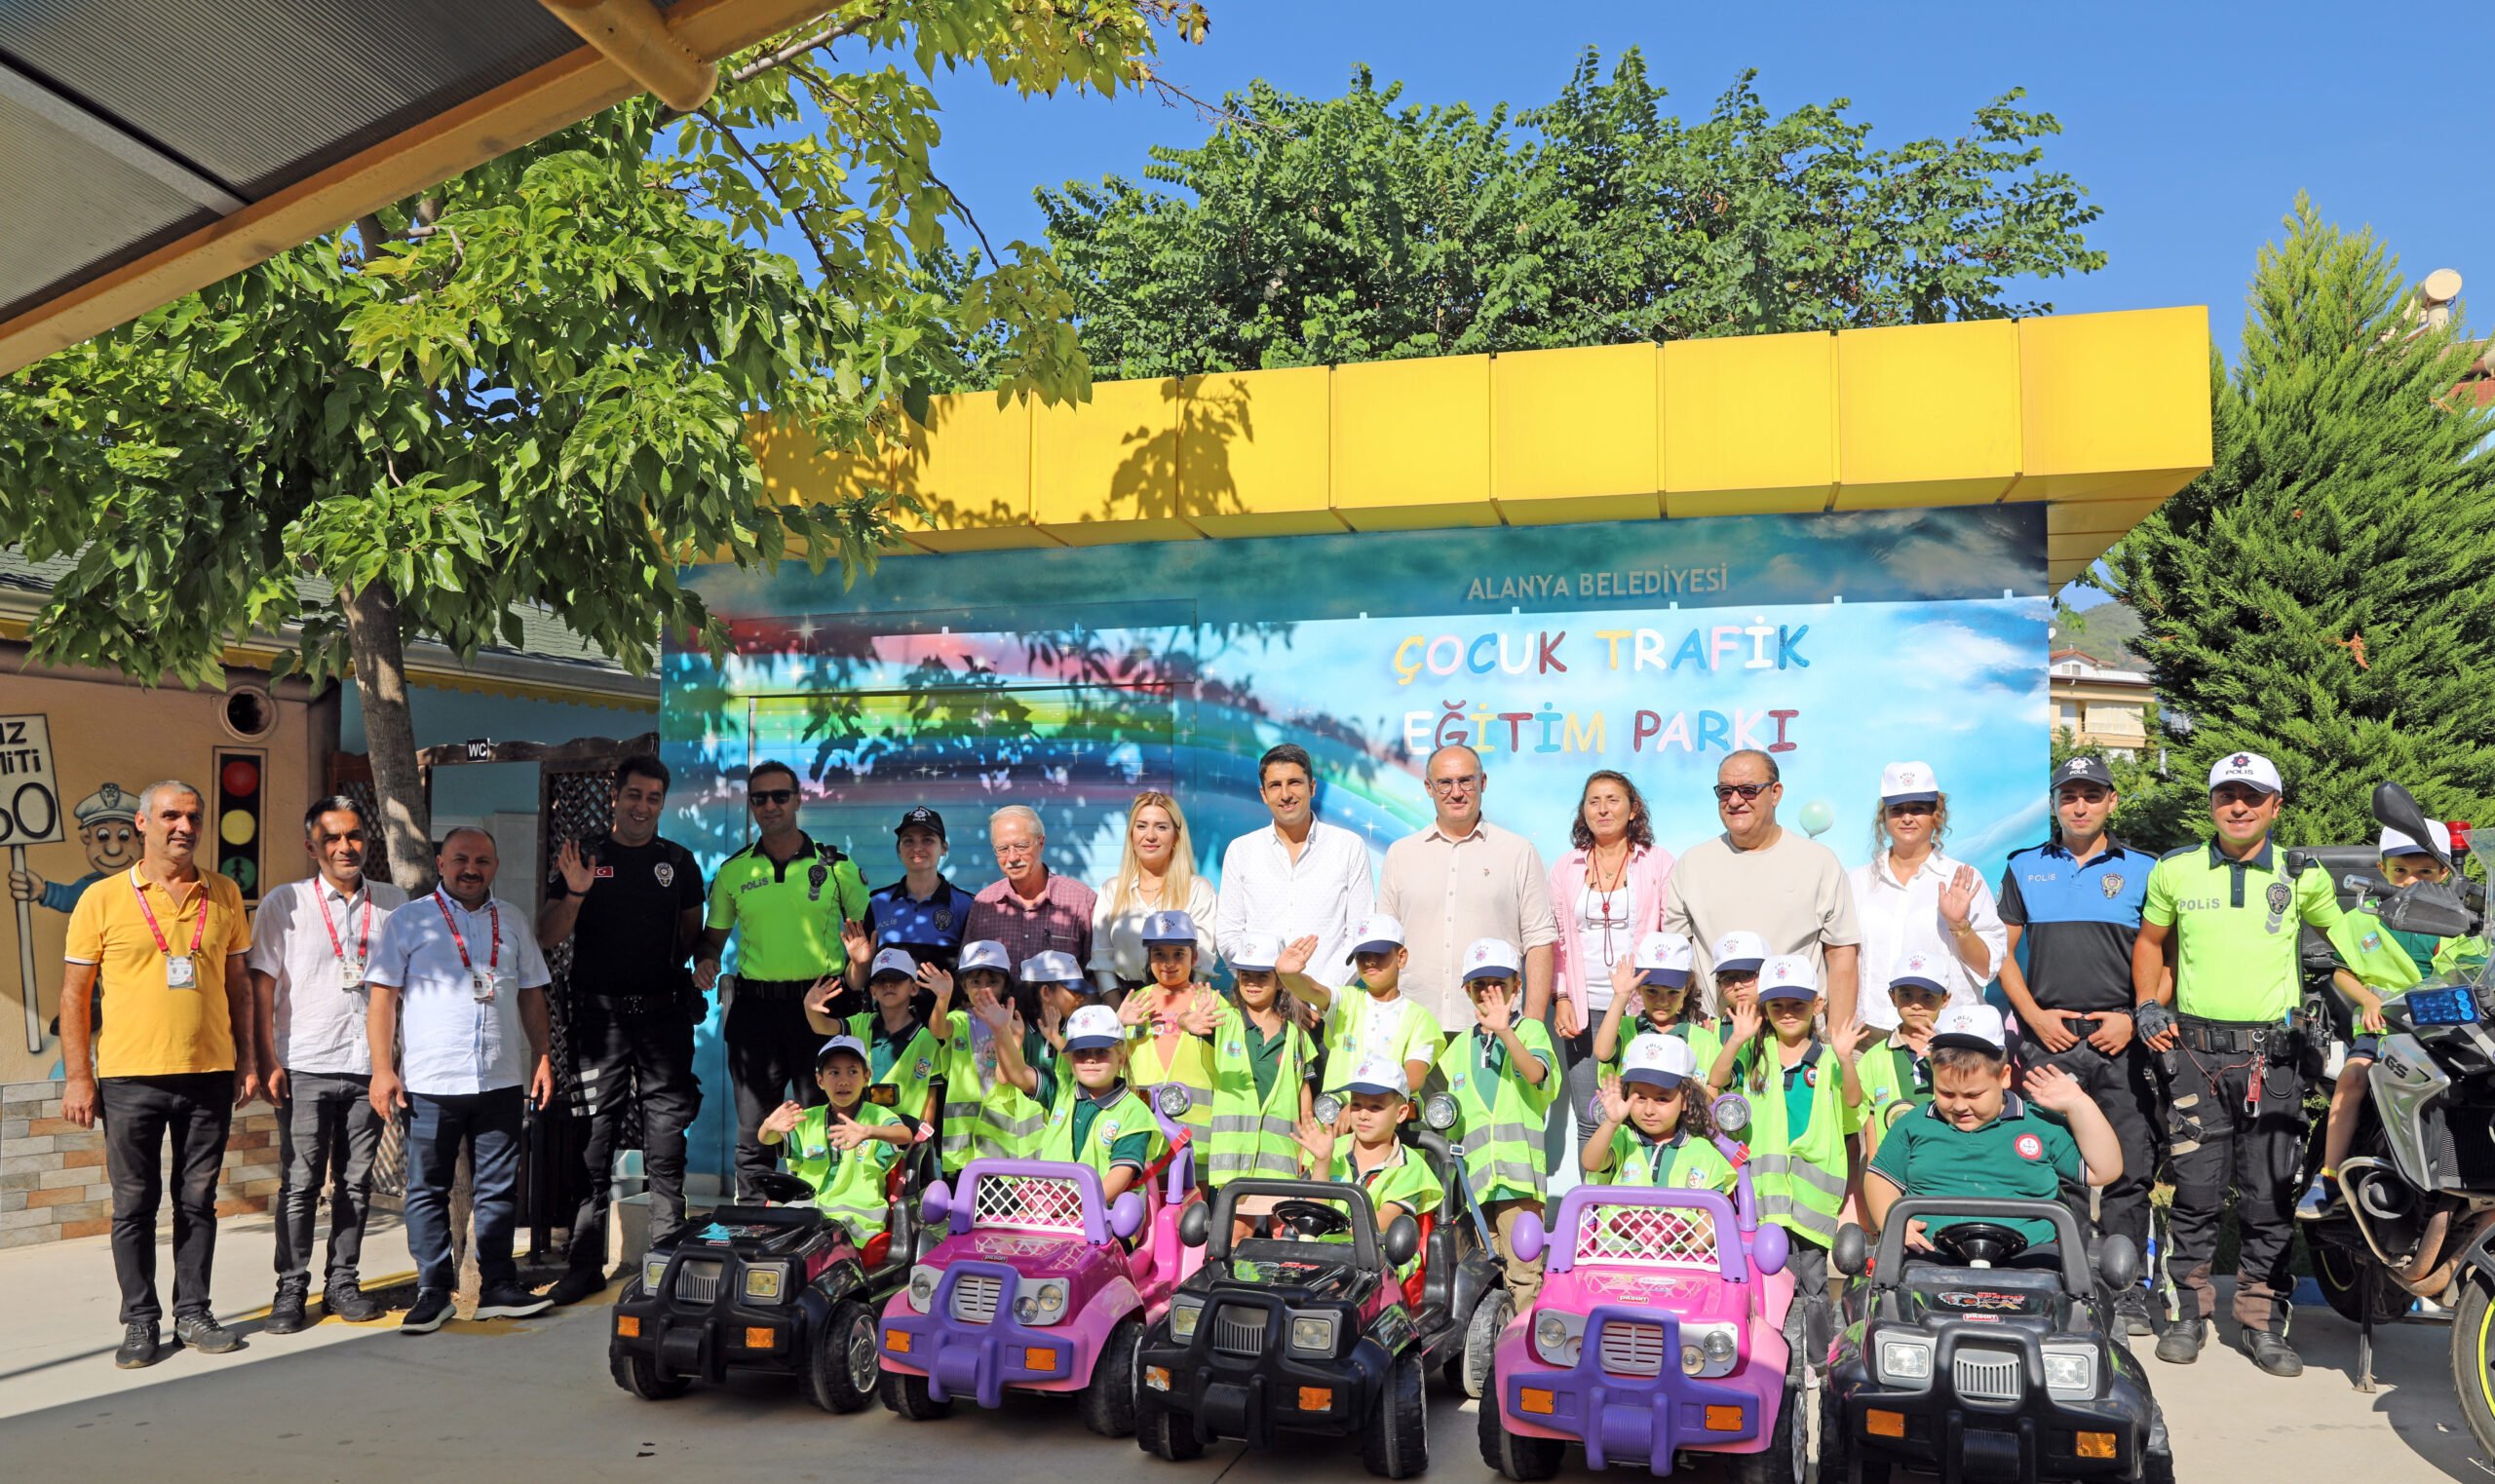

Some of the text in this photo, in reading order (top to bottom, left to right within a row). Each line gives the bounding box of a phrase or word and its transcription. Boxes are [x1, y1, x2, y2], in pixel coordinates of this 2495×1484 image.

[1467, 562, 1728, 600] ALANYA BELEDİYESİ
[1394, 615, 1810, 685] ÇOCUK TRAFİK
[1404, 699, 1800, 755] EĞİTİM PARKI
[468, 742, 487, 757] WC
[2384, 1054, 2409, 1079] GS
